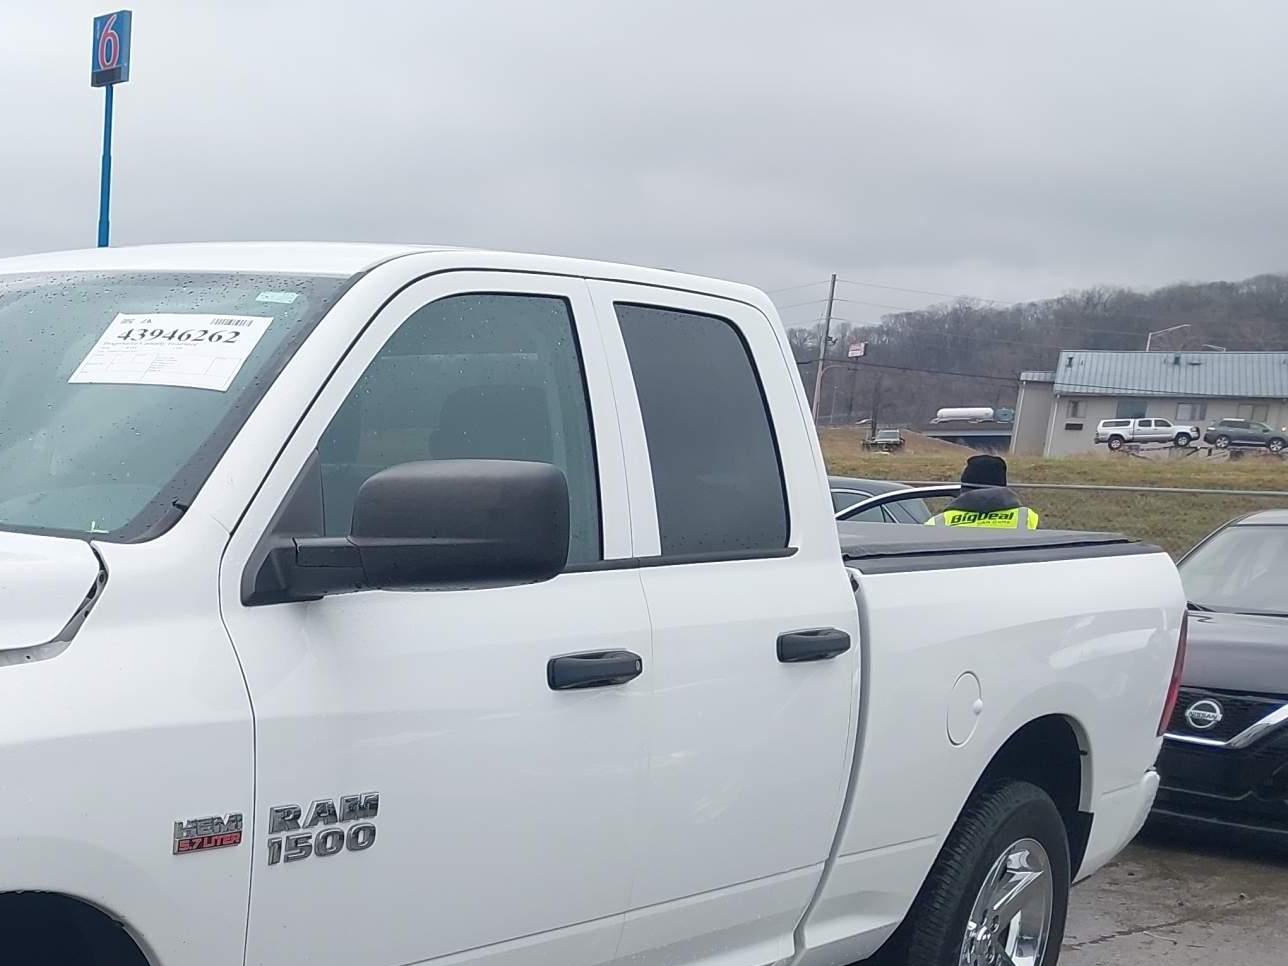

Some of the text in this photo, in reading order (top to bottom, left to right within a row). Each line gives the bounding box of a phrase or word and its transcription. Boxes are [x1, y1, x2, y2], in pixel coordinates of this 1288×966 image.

[98, 13, 120, 70] 6
[117, 329, 240, 343] 43946262
[1189, 711, 1218, 720] NISSAN
[267, 791, 380, 834] RAM
[174, 813, 243, 840] HEMI
[178, 832, 241, 852] 5.7 LITER
[267, 822, 377, 866] 1500
